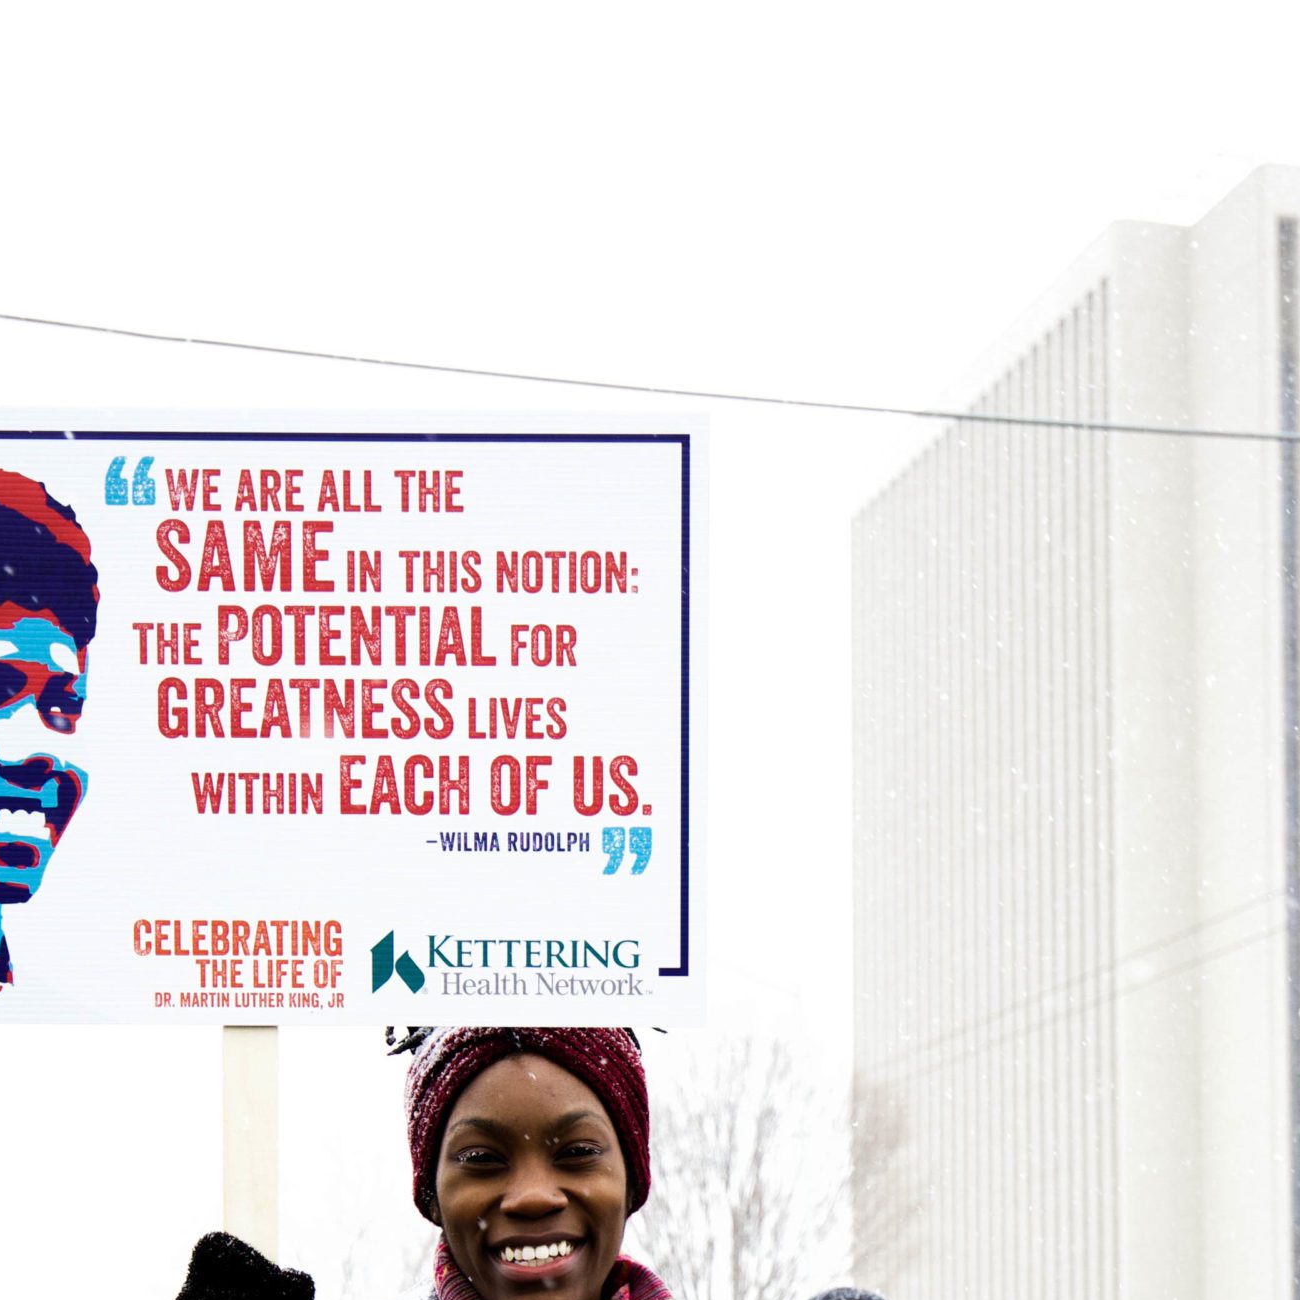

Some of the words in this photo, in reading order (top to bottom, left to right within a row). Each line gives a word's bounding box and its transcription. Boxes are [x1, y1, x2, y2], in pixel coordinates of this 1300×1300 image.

[234, 468, 305, 513] ARE
[317, 469, 383, 513] ALL
[393, 469, 465, 513] THE
[155, 518, 336, 593] SAME
[346, 550, 382, 593] IN
[398, 550, 483, 594] THIS
[496, 550, 639, 595] NOTION:
[131, 622, 203, 666] THE
[217, 603, 497, 667] POTENTIAL
[510, 623, 578, 668] FOR
[157, 676, 455, 741] GREATNESS
[467, 696, 568, 741] LIVES
[190, 771, 324, 815] WITHIN
[339, 753, 471, 816] EACH
[490, 754, 553, 817] OF
[572, 754, 653, 817] US.
[507, 831, 590, 853] RUDOLPH
[133, 919, 343, 957] CELEBRATING
[426, 934, 641, 969] KETTERING
[195, 958, 244, 989] THE
[252, 958, 305, 989] LIFE
[313, 958, 344, 989] OF
[441, 972, 528, 996] Health
[154, 991, 175, 1008] DR.
[179, 991, 230, 1008] MARTIN
[234, 991, 285, 1008] LUTHER
[288, 991, 323, 1010] KING,
[327, 991, 345, 1008] JR
